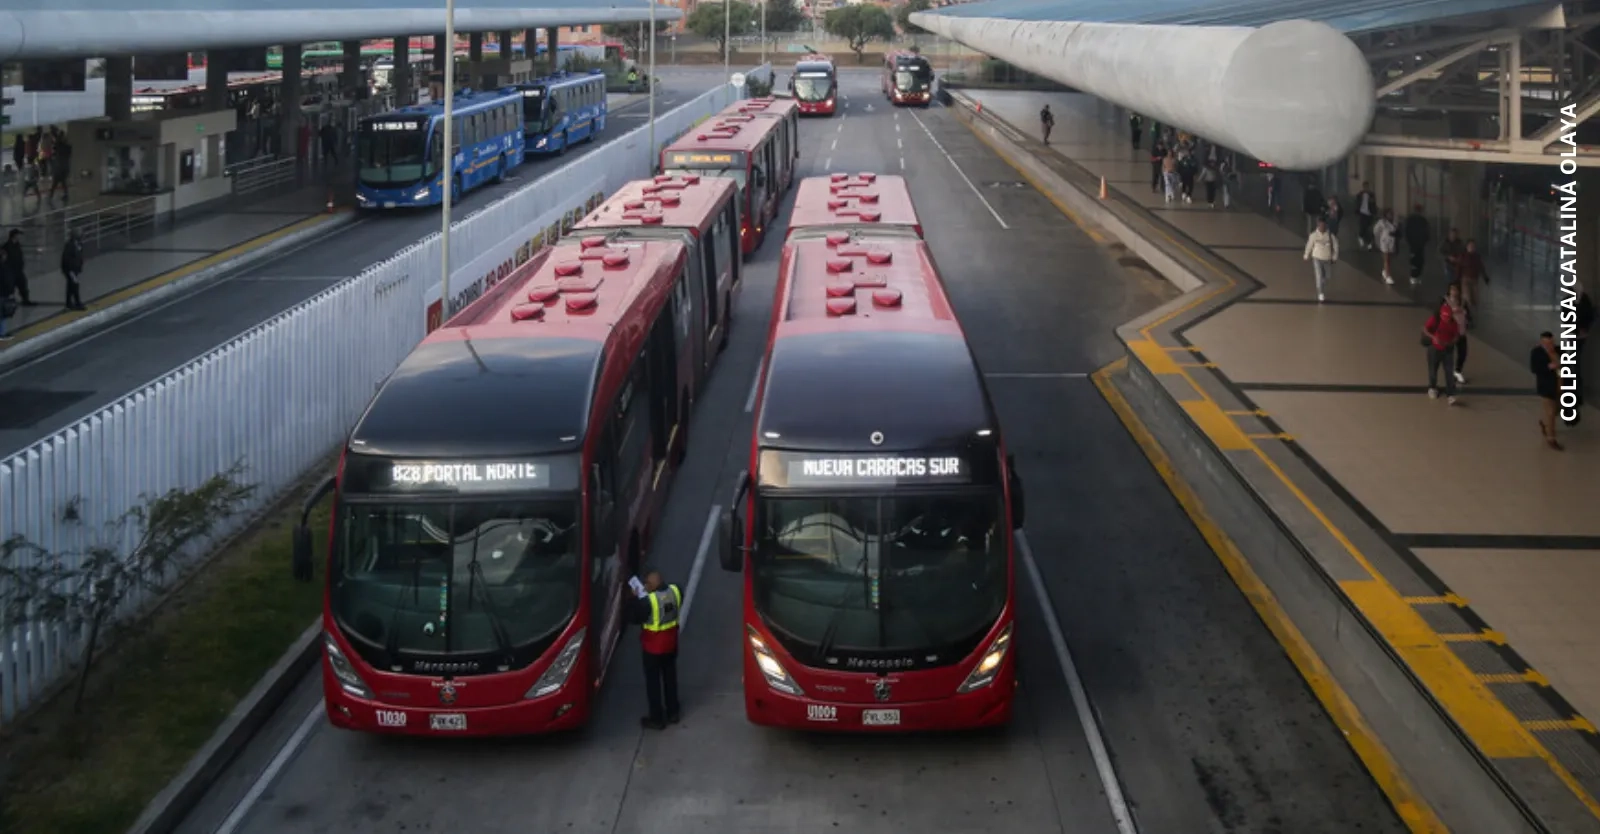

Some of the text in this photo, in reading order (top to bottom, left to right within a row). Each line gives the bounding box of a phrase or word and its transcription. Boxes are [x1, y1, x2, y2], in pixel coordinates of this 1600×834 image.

[423, 463, 482, 482] PORTAL
[803, 456, 960, 477] NUEVA CARACAS SUR
[375, 710, 407, 726] T1030
[807, 704, 838, 719] U1009
